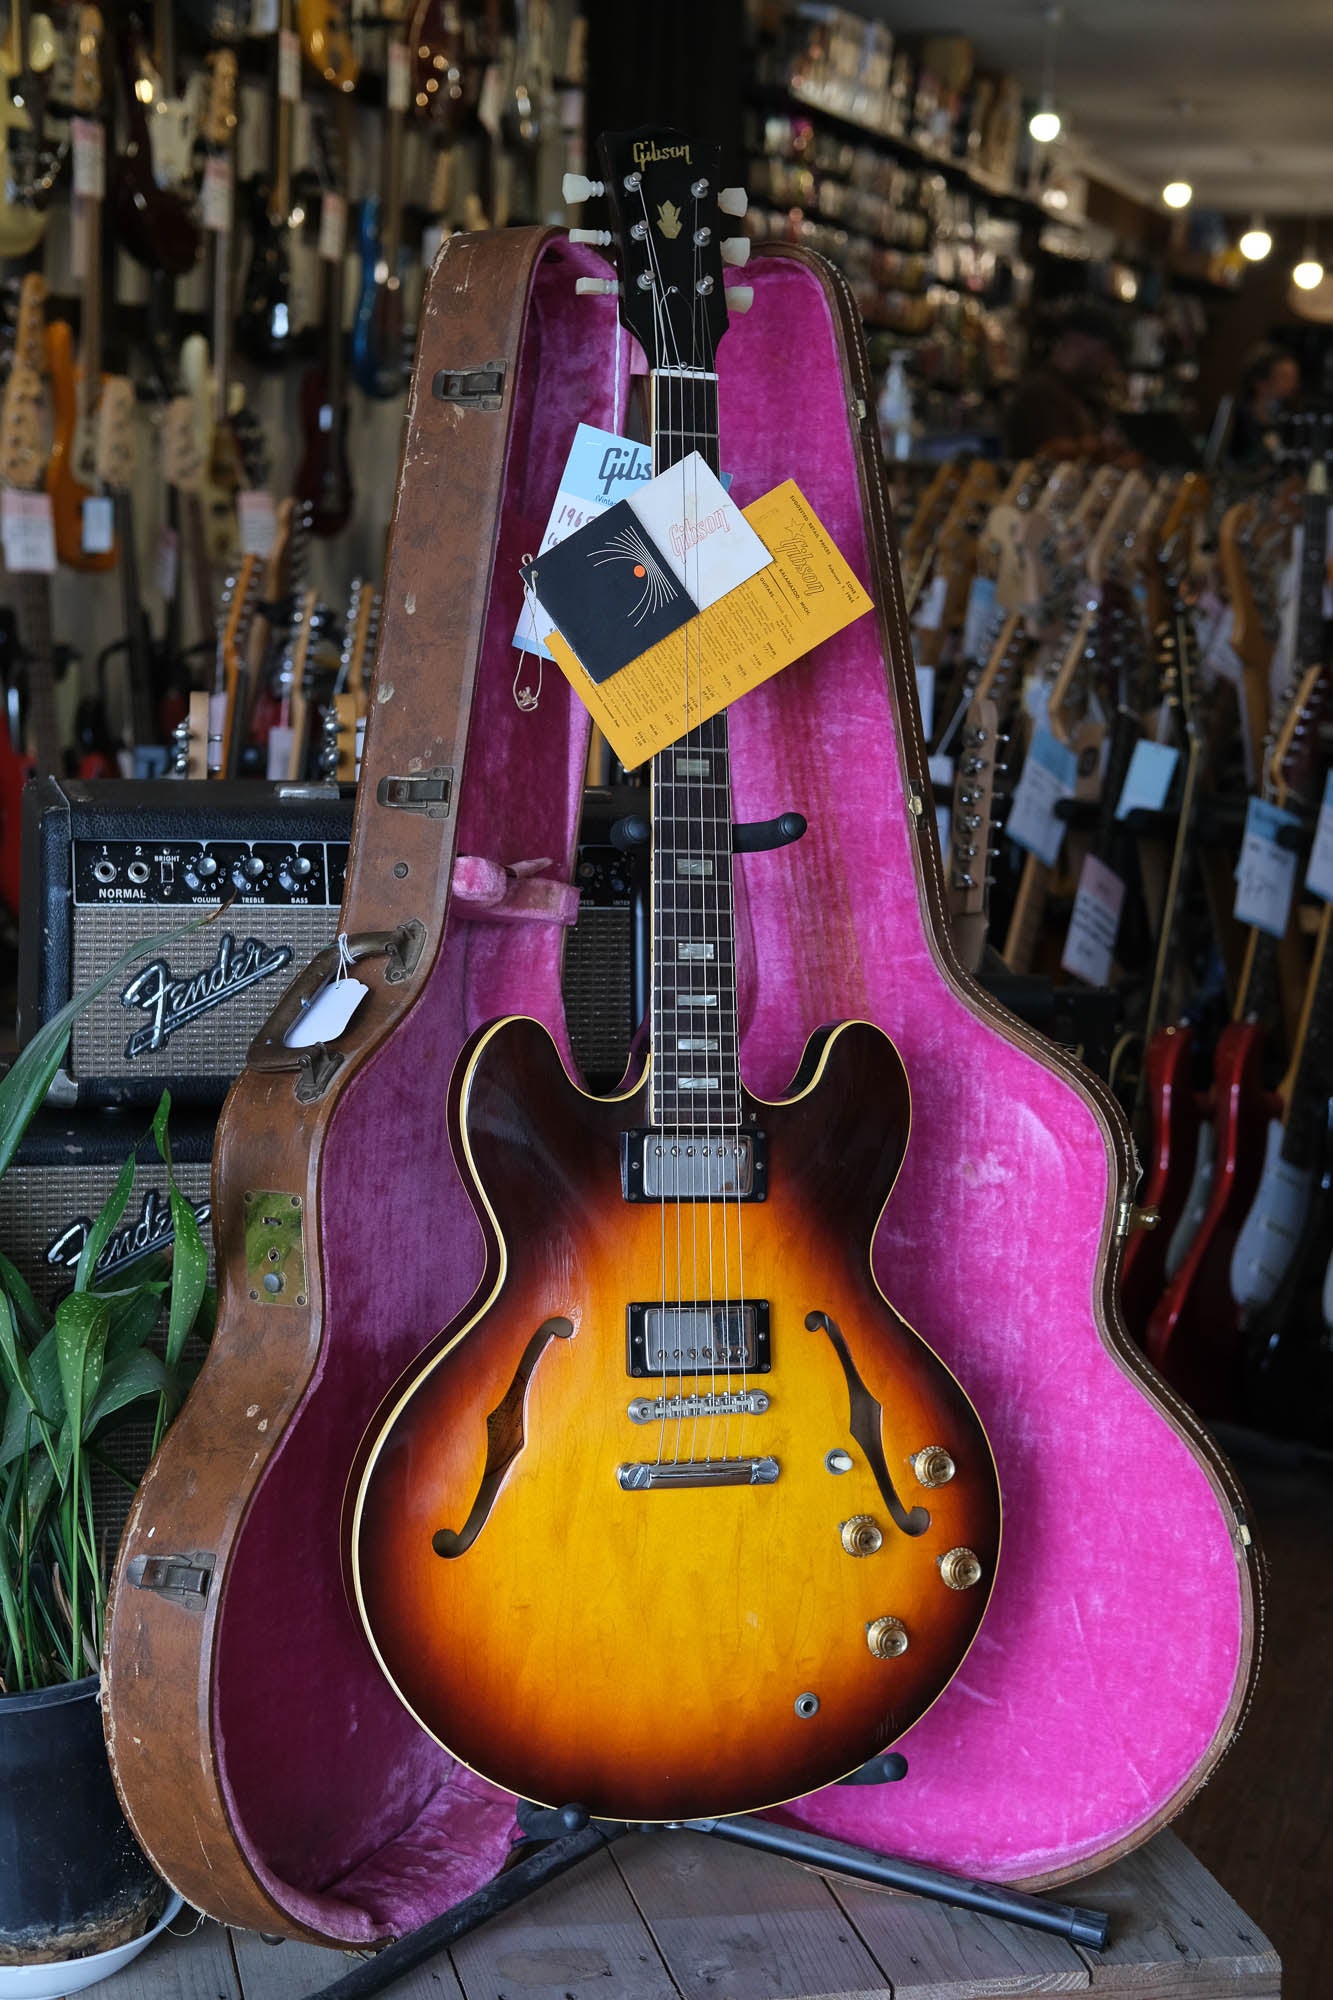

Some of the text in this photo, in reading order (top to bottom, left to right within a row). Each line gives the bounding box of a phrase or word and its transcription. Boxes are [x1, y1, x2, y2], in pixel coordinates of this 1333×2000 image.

[633, 140, 693, 172] Gibson
[598, 447, 652, 495] Gibs
[668, 508, 731, 564] Gibson
[789, 494, 831, 555] SUGGESTED RETAIL PRICES
[774, 534, 825, 598] Gibson
[827, 563, 842, 585] February
[845, 580, 857, 595] ZONE
[102, 845, 142, 856] 1 2
[98, 888, 147, 898] NORMAL
[121, 932, 292, 1058] Fender
